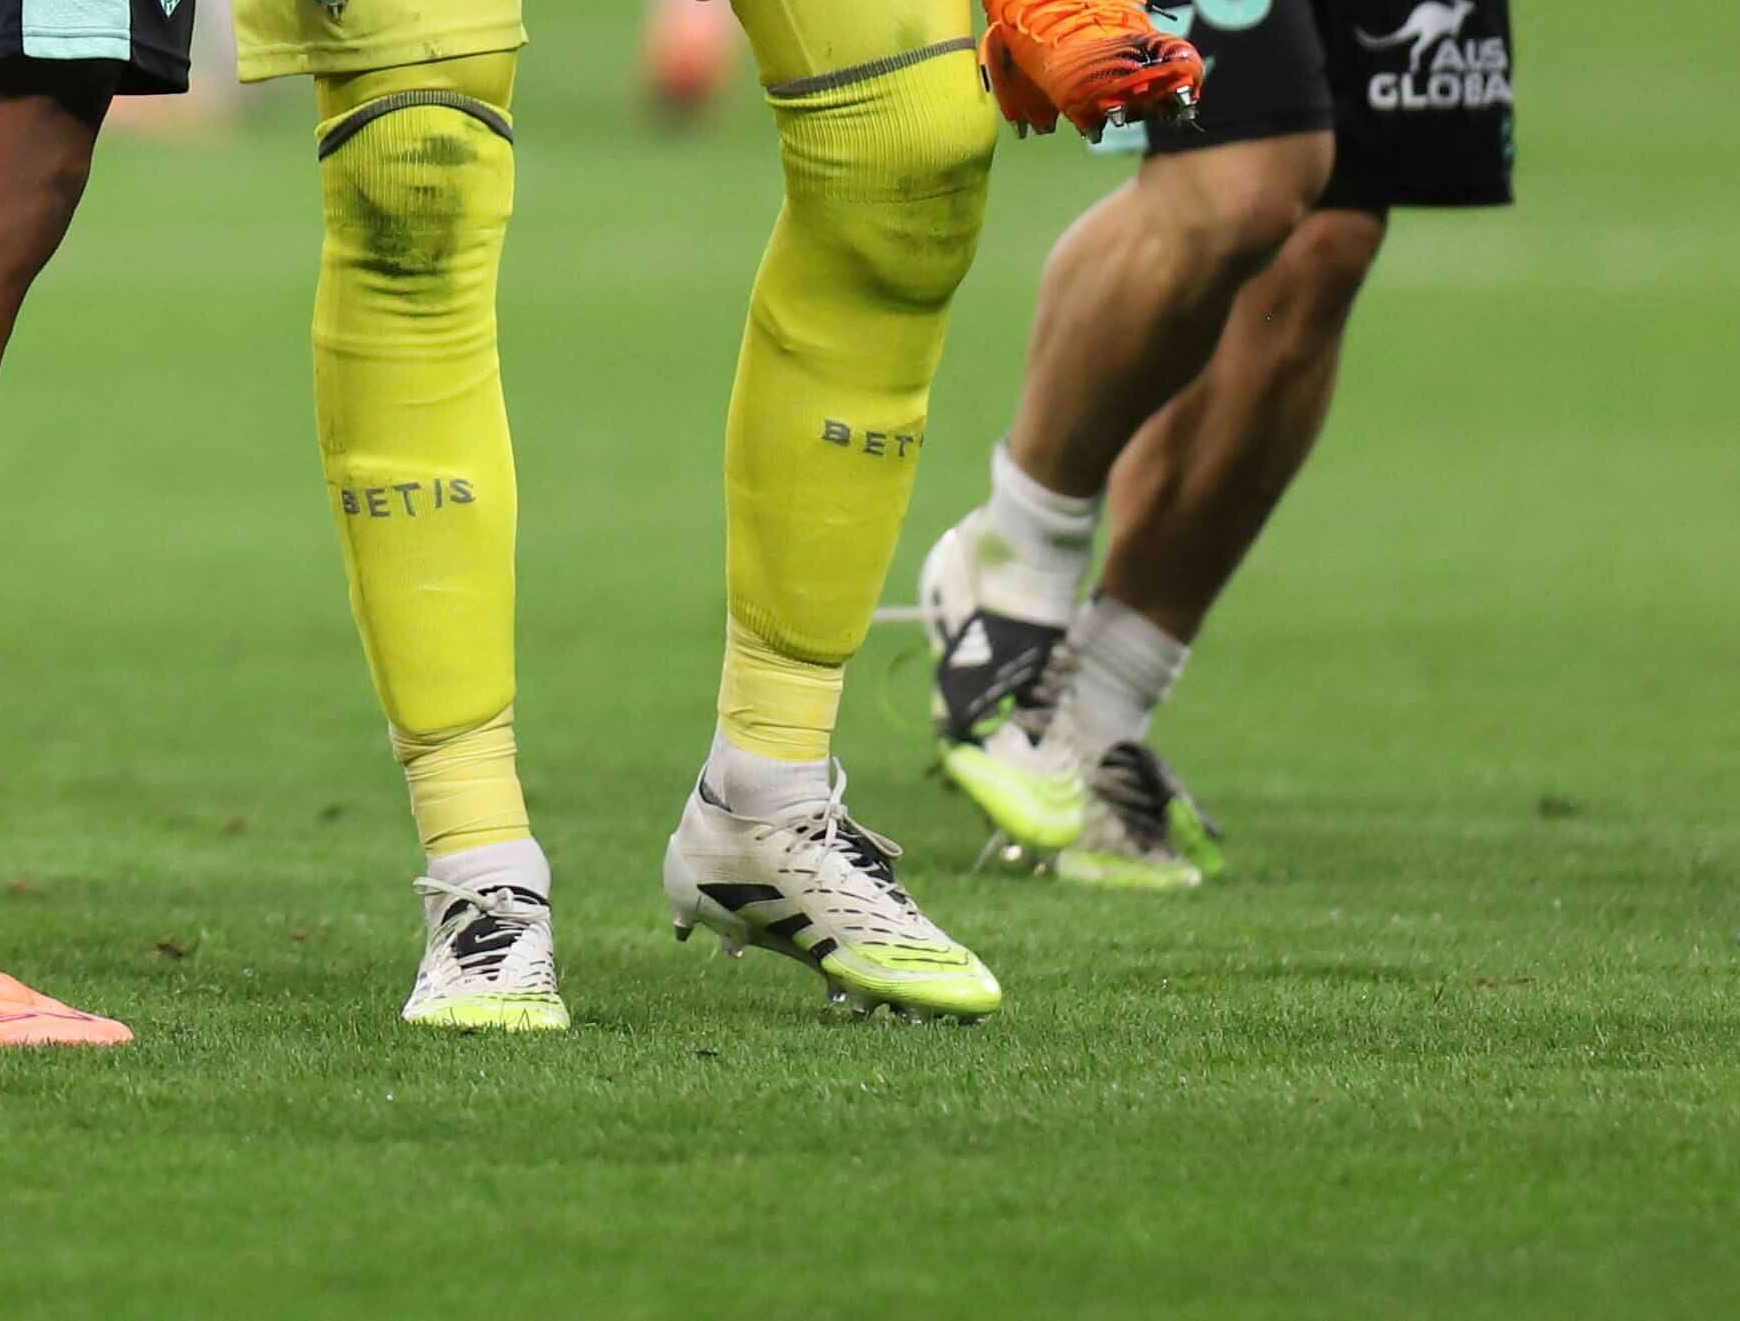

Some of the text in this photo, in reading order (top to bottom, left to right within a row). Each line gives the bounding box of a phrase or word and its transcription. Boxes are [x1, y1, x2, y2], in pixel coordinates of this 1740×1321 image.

[1430, 37, 1509, 73] AUS
[1367, 71, 1513, 111] GLOBA
[822, 419, 924, 458] BET
[341, 478, 476, 519] BETIS
